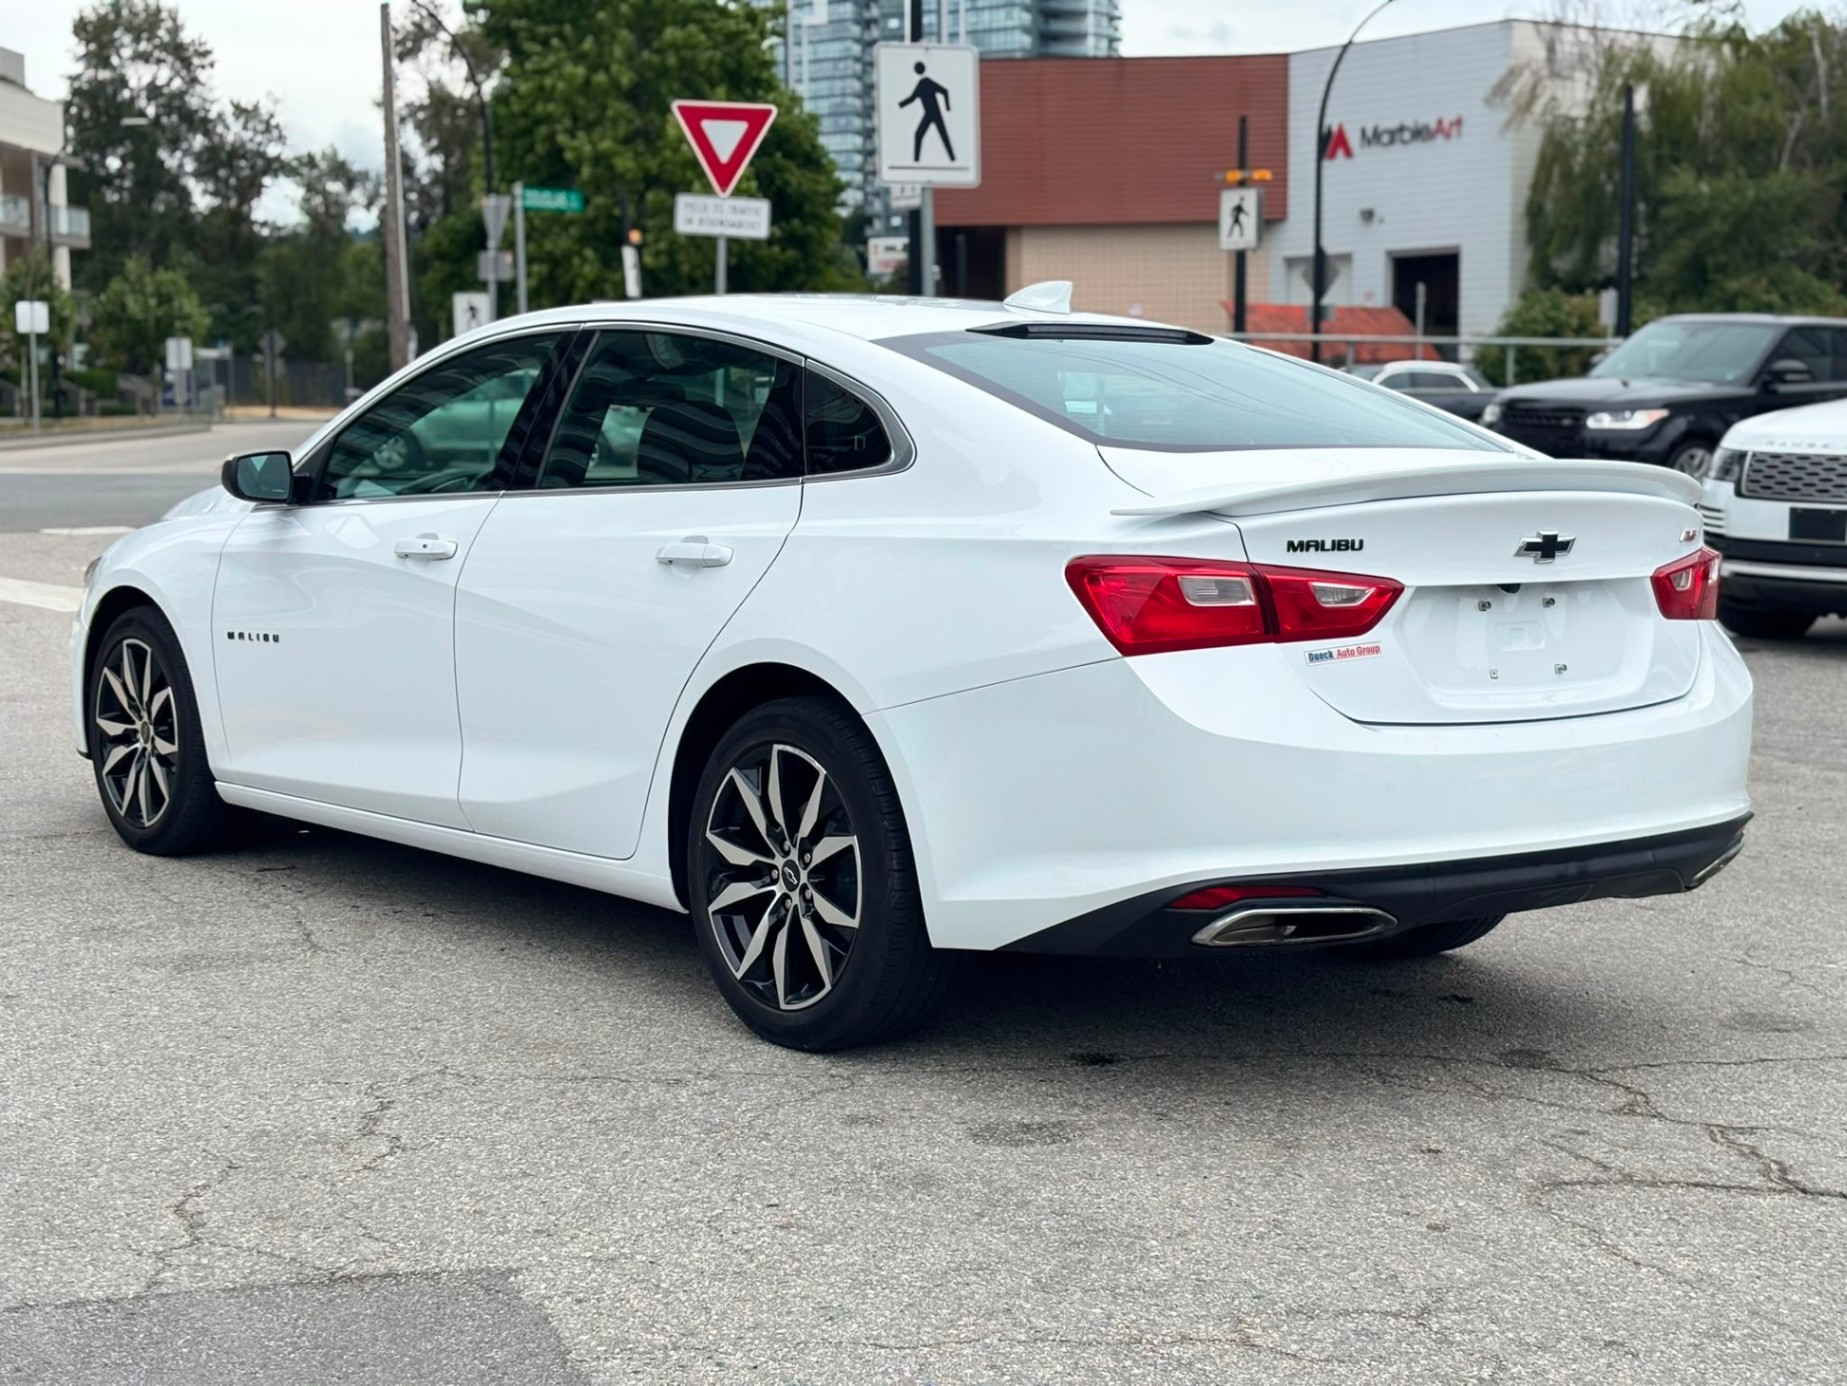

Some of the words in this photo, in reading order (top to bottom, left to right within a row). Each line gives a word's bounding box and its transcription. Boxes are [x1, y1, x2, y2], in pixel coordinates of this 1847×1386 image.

[1360, 115, 1463, 148] MarbleArt
[1286, 539, 1364, 553] MALIBU
[227, 631, 280, 643] MALIBU
[1307, 650, 1334, 663] Dueck
[1336, 648, 1355, 658] Auto
[1356, 645, 1380, 657] Group
